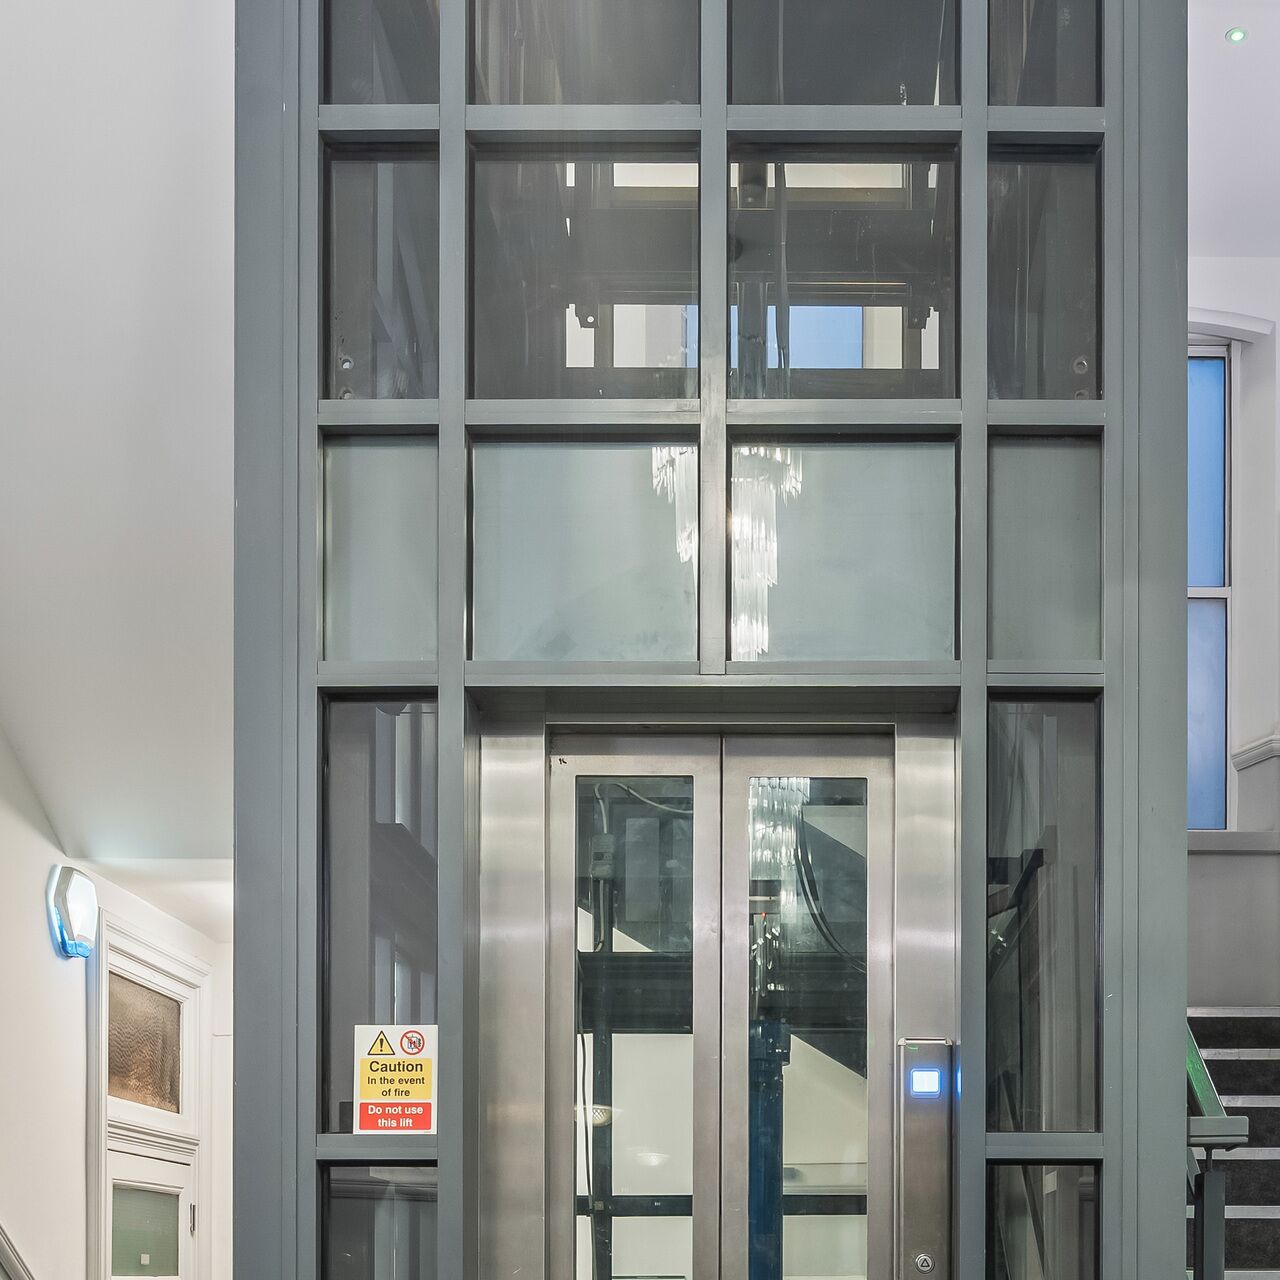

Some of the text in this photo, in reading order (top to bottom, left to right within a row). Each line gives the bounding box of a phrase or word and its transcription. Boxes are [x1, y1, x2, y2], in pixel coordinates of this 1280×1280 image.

[369, 1060, 423, 1072] Caution
[367, 1076, 425, 1085] In the event
[381, 1088, 411, 1097] of fire
[368, 1105, 423, 1115] Do not use
[378, 1118, 413, 1127] this lift
